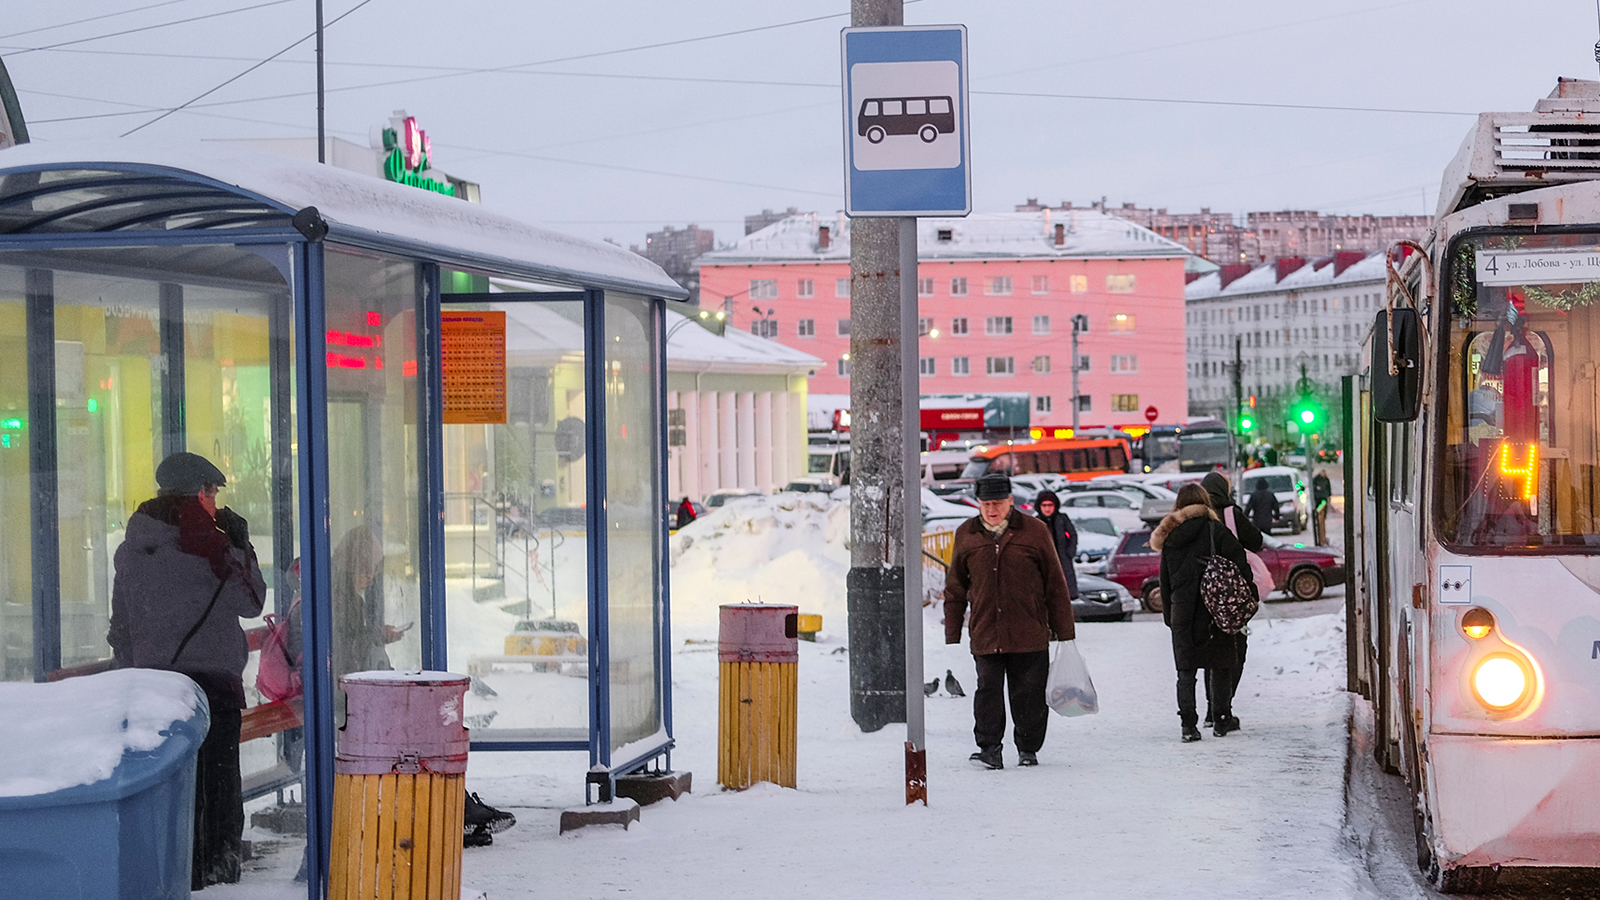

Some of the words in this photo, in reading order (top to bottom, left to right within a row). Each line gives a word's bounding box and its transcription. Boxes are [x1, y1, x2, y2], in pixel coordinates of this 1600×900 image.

[1485, 255, 1499, 276] 4
[1506, 261, 1521, 271] ул.
[1523, 258, 1561, 269] Лобова
[1569, 259, 1584, 269] ул.
[1587, 257, 1600, 267] Щ
[1500, 443, 1536, 499] 4
